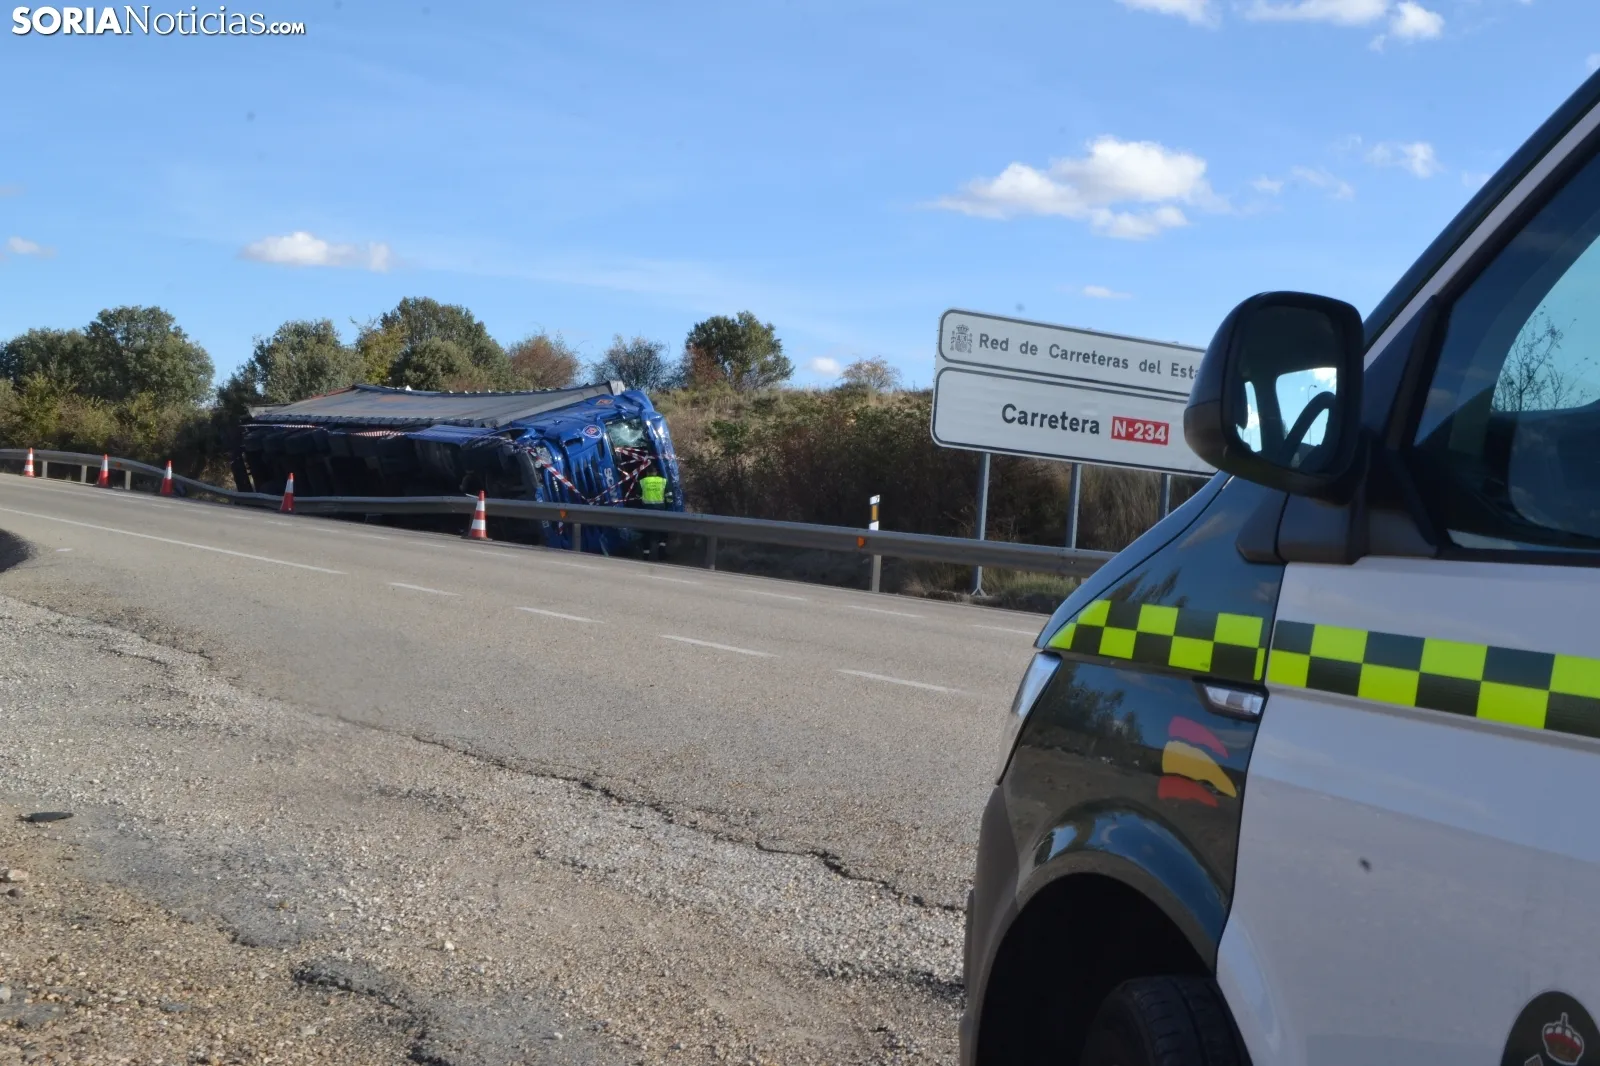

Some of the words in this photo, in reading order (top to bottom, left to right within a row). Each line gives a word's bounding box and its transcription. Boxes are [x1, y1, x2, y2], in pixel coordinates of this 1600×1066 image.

[979, 333, 1009, 352] Red
[1019, 340, 1038, 356] de
[1049, 343, 1129, 370] Carreteras
[1139, 359, 1161, 375] del
[1001, 403, 1100, 436] Carretera
[1113, 418, 1167, 442] N-234
